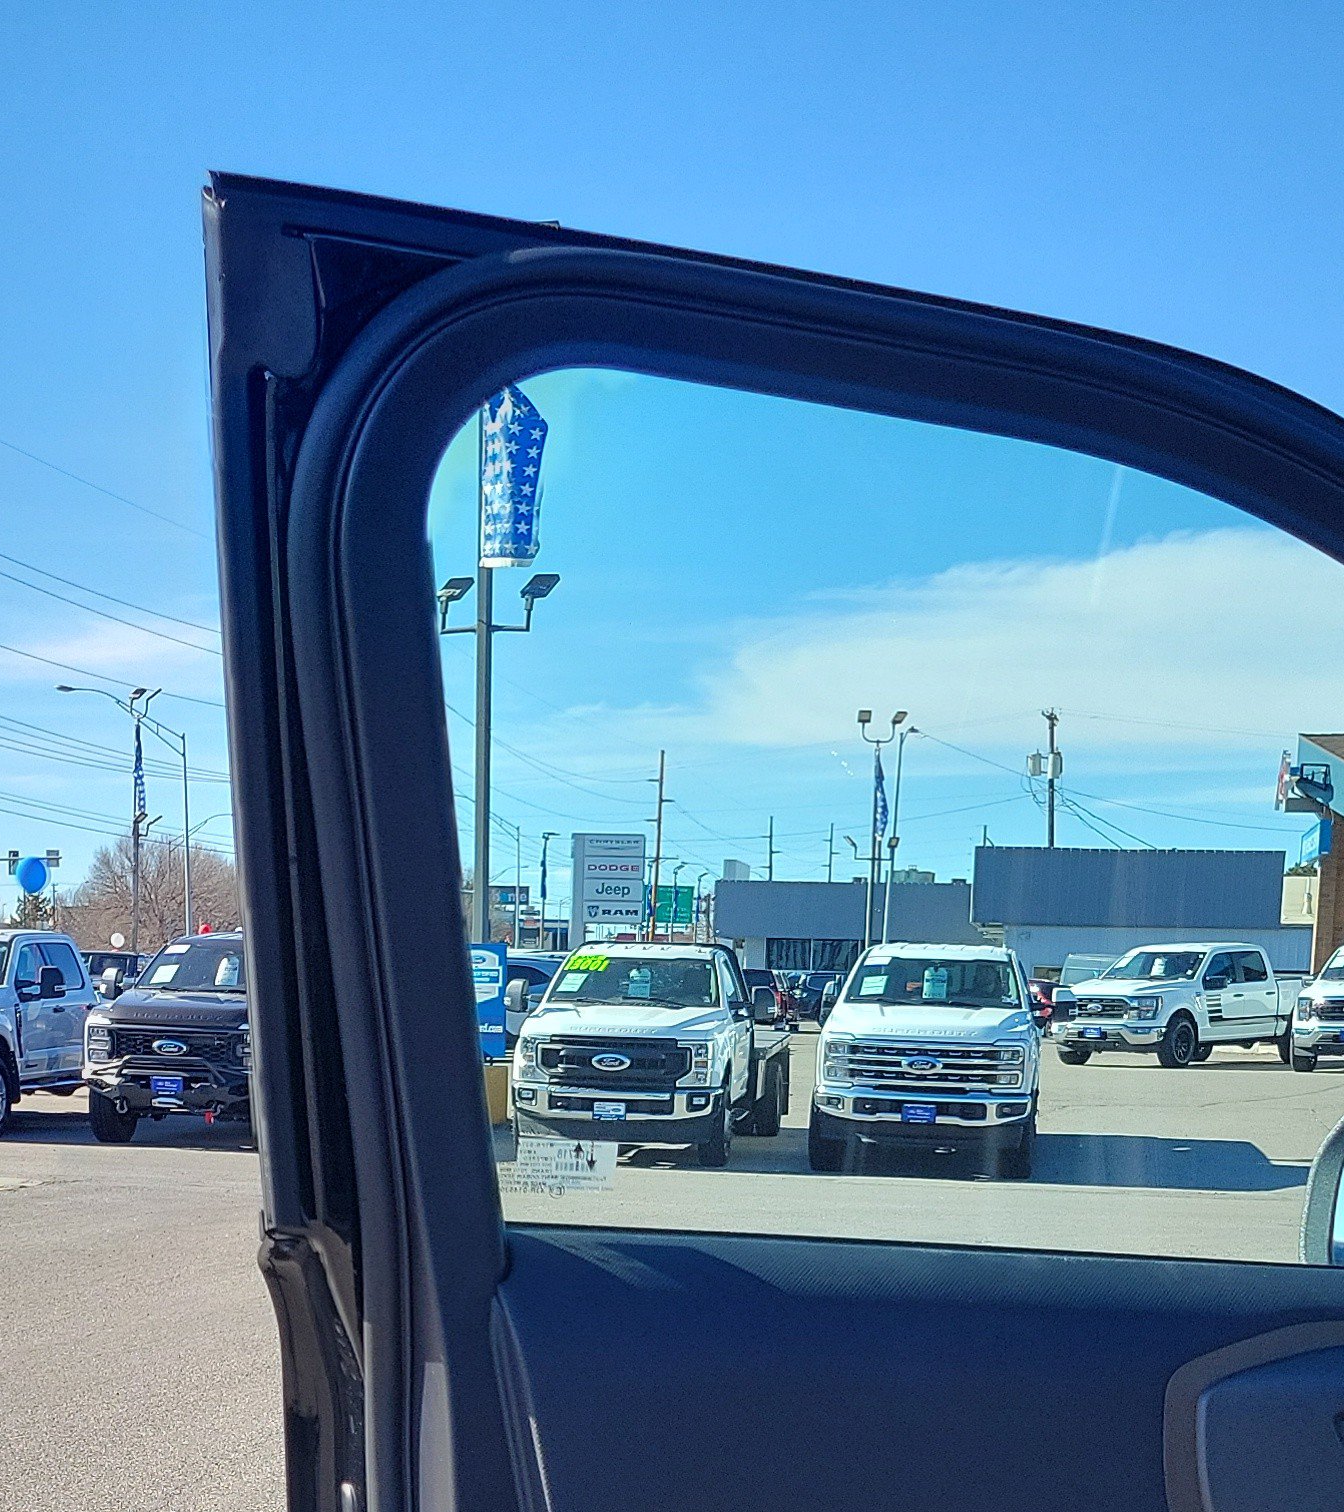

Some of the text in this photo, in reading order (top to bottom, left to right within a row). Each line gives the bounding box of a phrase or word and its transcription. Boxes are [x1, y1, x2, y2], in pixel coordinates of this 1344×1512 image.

[587, 864, 640, 872] DODGE
[596, 882, 631, 898] Jeep
[601, 909, 639, 917] RAM
[600, 1057, 621, 1067] Ford
[912, 1060, 932, 1069] Ford
